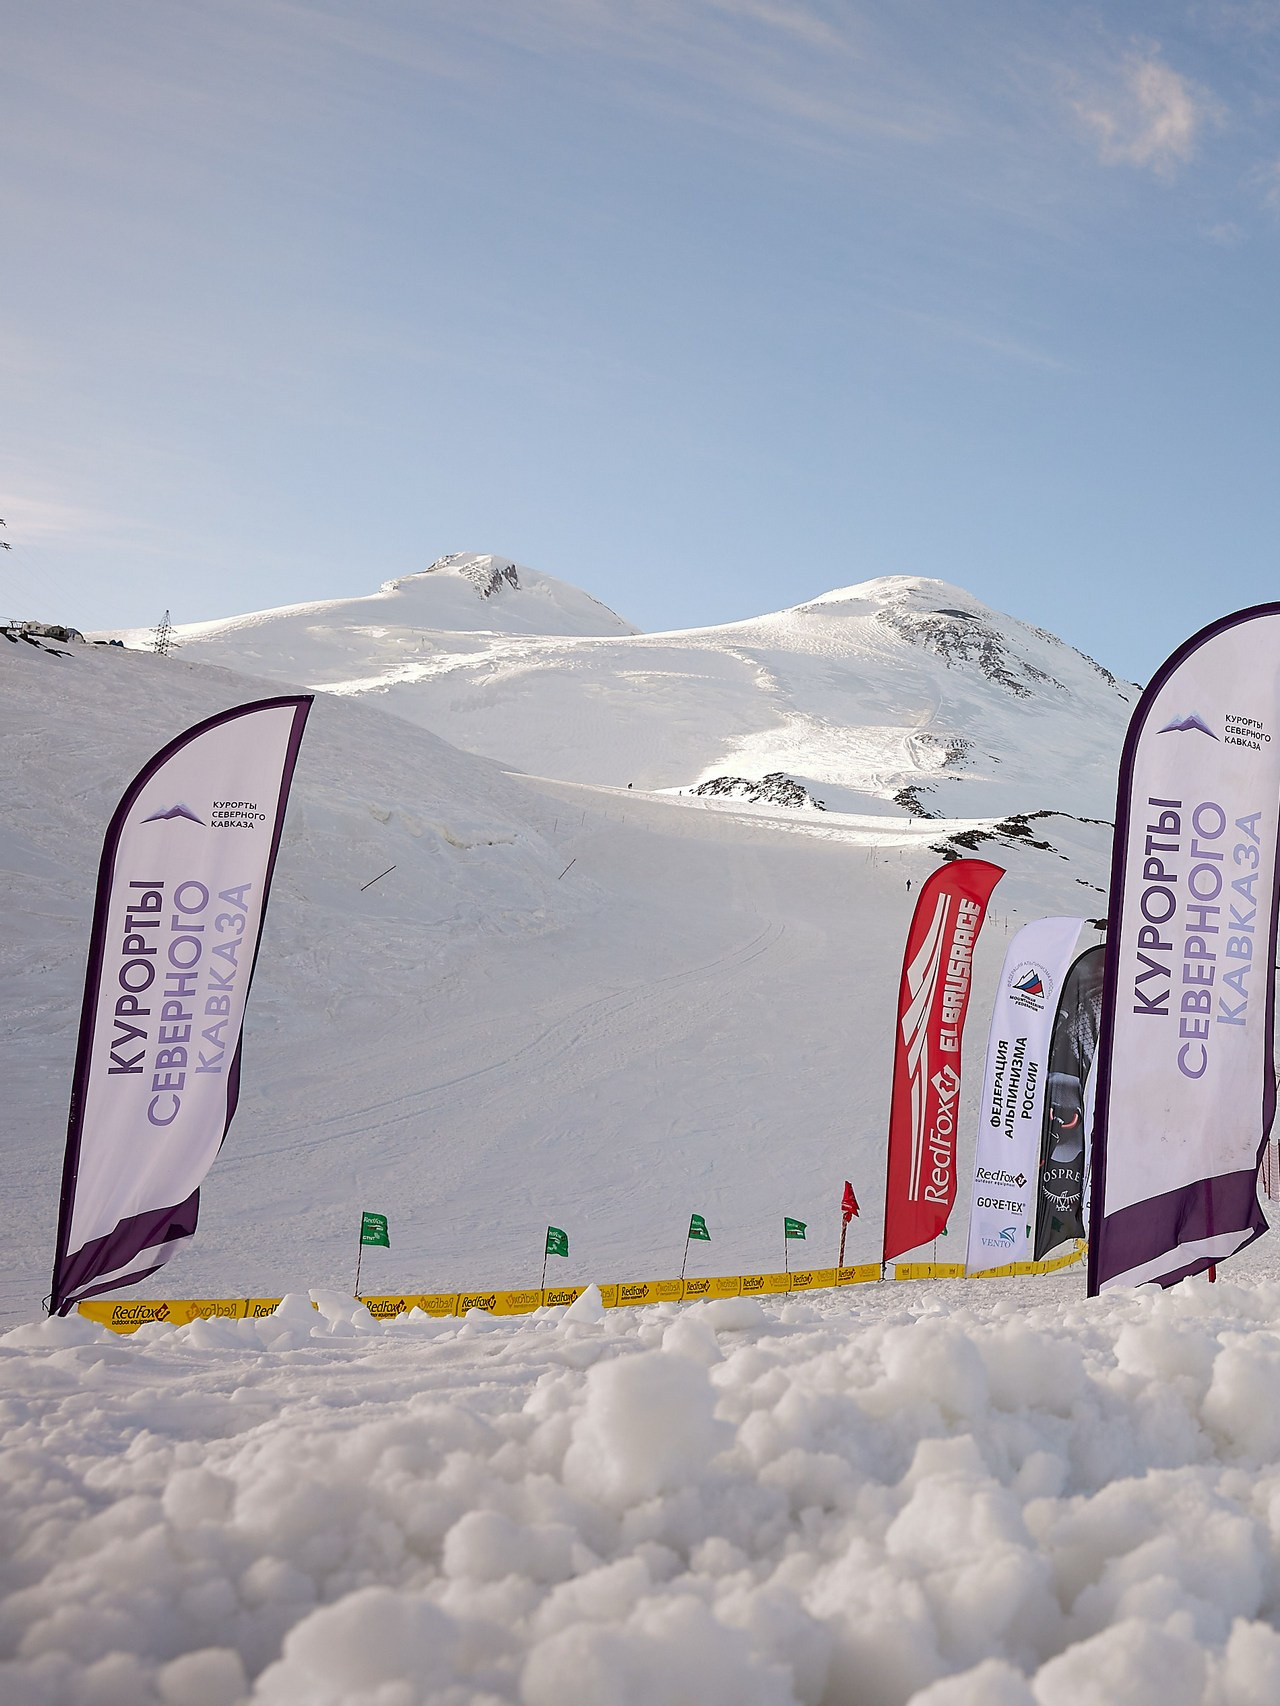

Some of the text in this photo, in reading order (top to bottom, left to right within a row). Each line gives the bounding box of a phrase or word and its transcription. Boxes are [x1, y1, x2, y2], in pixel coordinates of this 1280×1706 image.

[1225, 714, 1263, 730] КУРОРТЫ
[1225, 725, 1271, 742] СЕВЕРНОГО
[1224, 735, 1261, 751] КАВКАЗА
[213, 801, 257, 811] КУРОРТЫ
[211, 820, 254, 829] КАВКАЗА
[212, 811, 266, 821] СЕВЕРНОГО
[1133, 797, 1182, 1016] КУРОРТЫ
[1216, 811, 1262, 1026] КАВКАЗА
[1177, 801, 1226, 1080] СЕВЕРНОГО
[108, 880, 164, 1075] КУРОРТЫ
[194, 882, 252, 1074] КАВКАЗА
[147, 880, 209, 1127] СЕВЕРНОГО
[924, 898, 981, 1205] RedFox ELBRUSRACE
[989, 1039, 1010, 1129] ФЕДЕРАЦИЯ
[1004, 1036, 1028, 1140] АЛЬПИНИЗМА
[1021, 1061, 1039, 1120] РОССИИ
[976, 1167, 1016, 1184] RedFox
[1043, 1168, 1081, 1183] OSPRE
[981, 1237, 1012, 1249] VENTO
[112, 1305, 158, 1319] RedFox
[366, 1300, 397, 1313] RedFox
